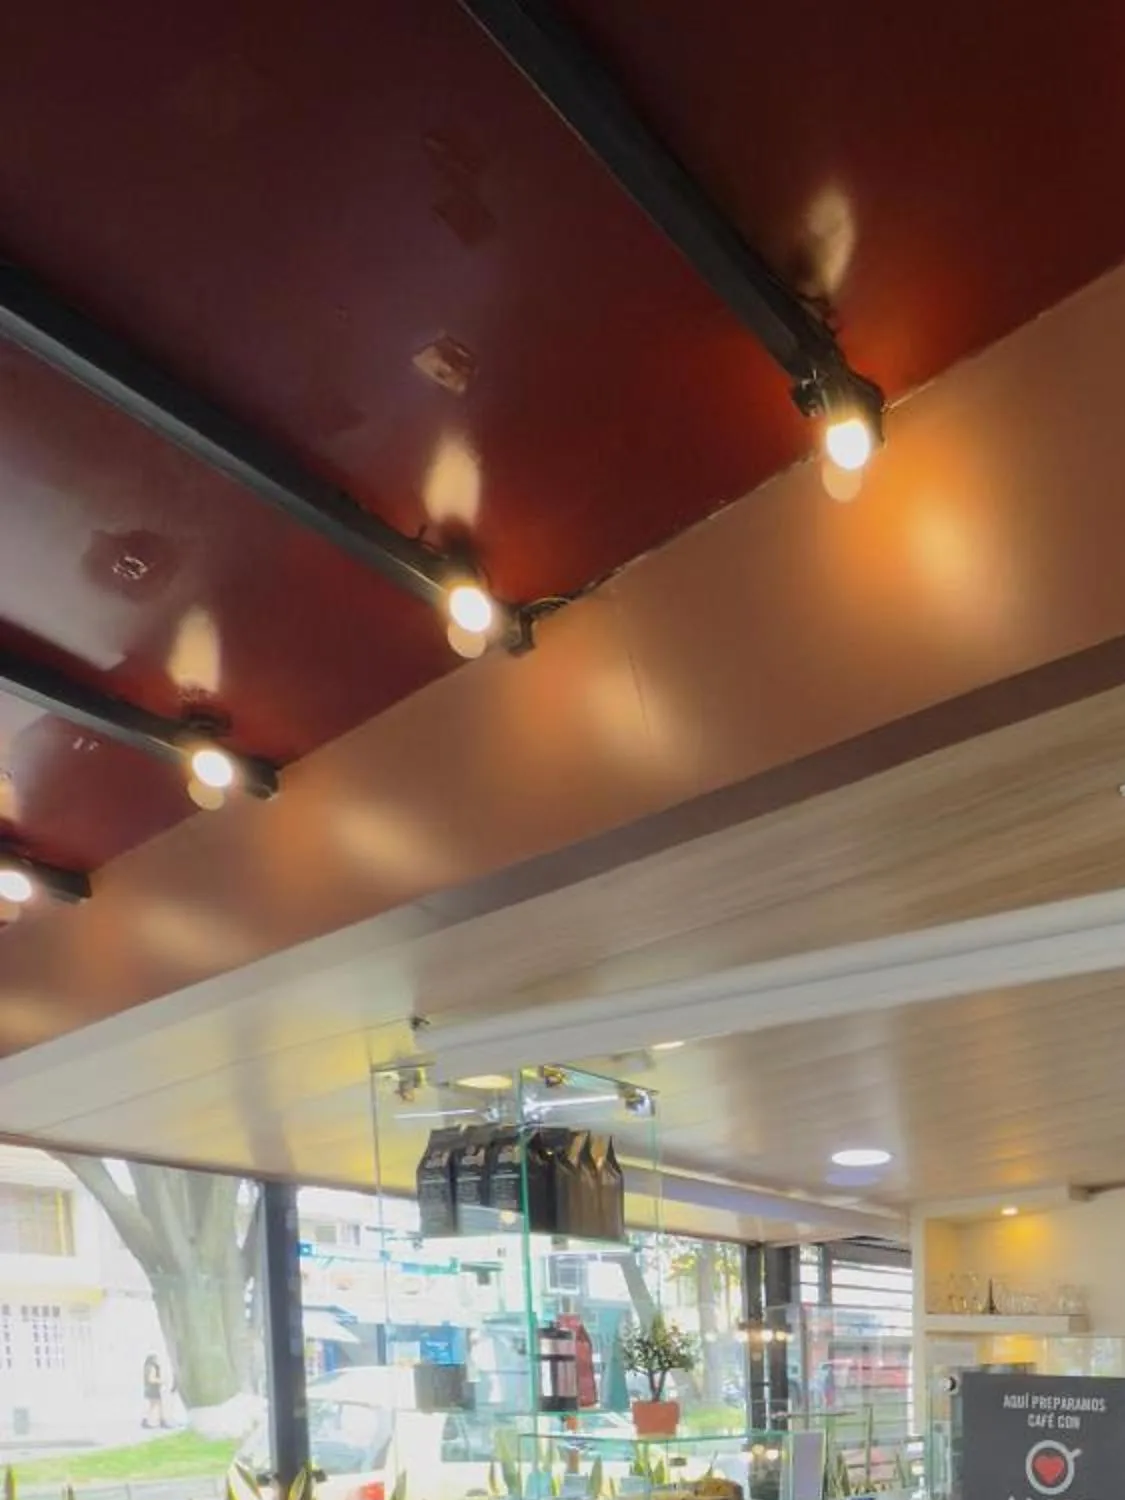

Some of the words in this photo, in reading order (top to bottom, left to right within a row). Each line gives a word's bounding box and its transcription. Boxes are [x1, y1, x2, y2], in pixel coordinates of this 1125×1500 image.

[1003, 1392, 1029, 1409] AQUÍ
[1030, 1395, 1106, 1412] PREPARAMOS
[1027, 1412, 1055, 1428] CAFÉ
[1057, 1414, 1081, 1429] CON
